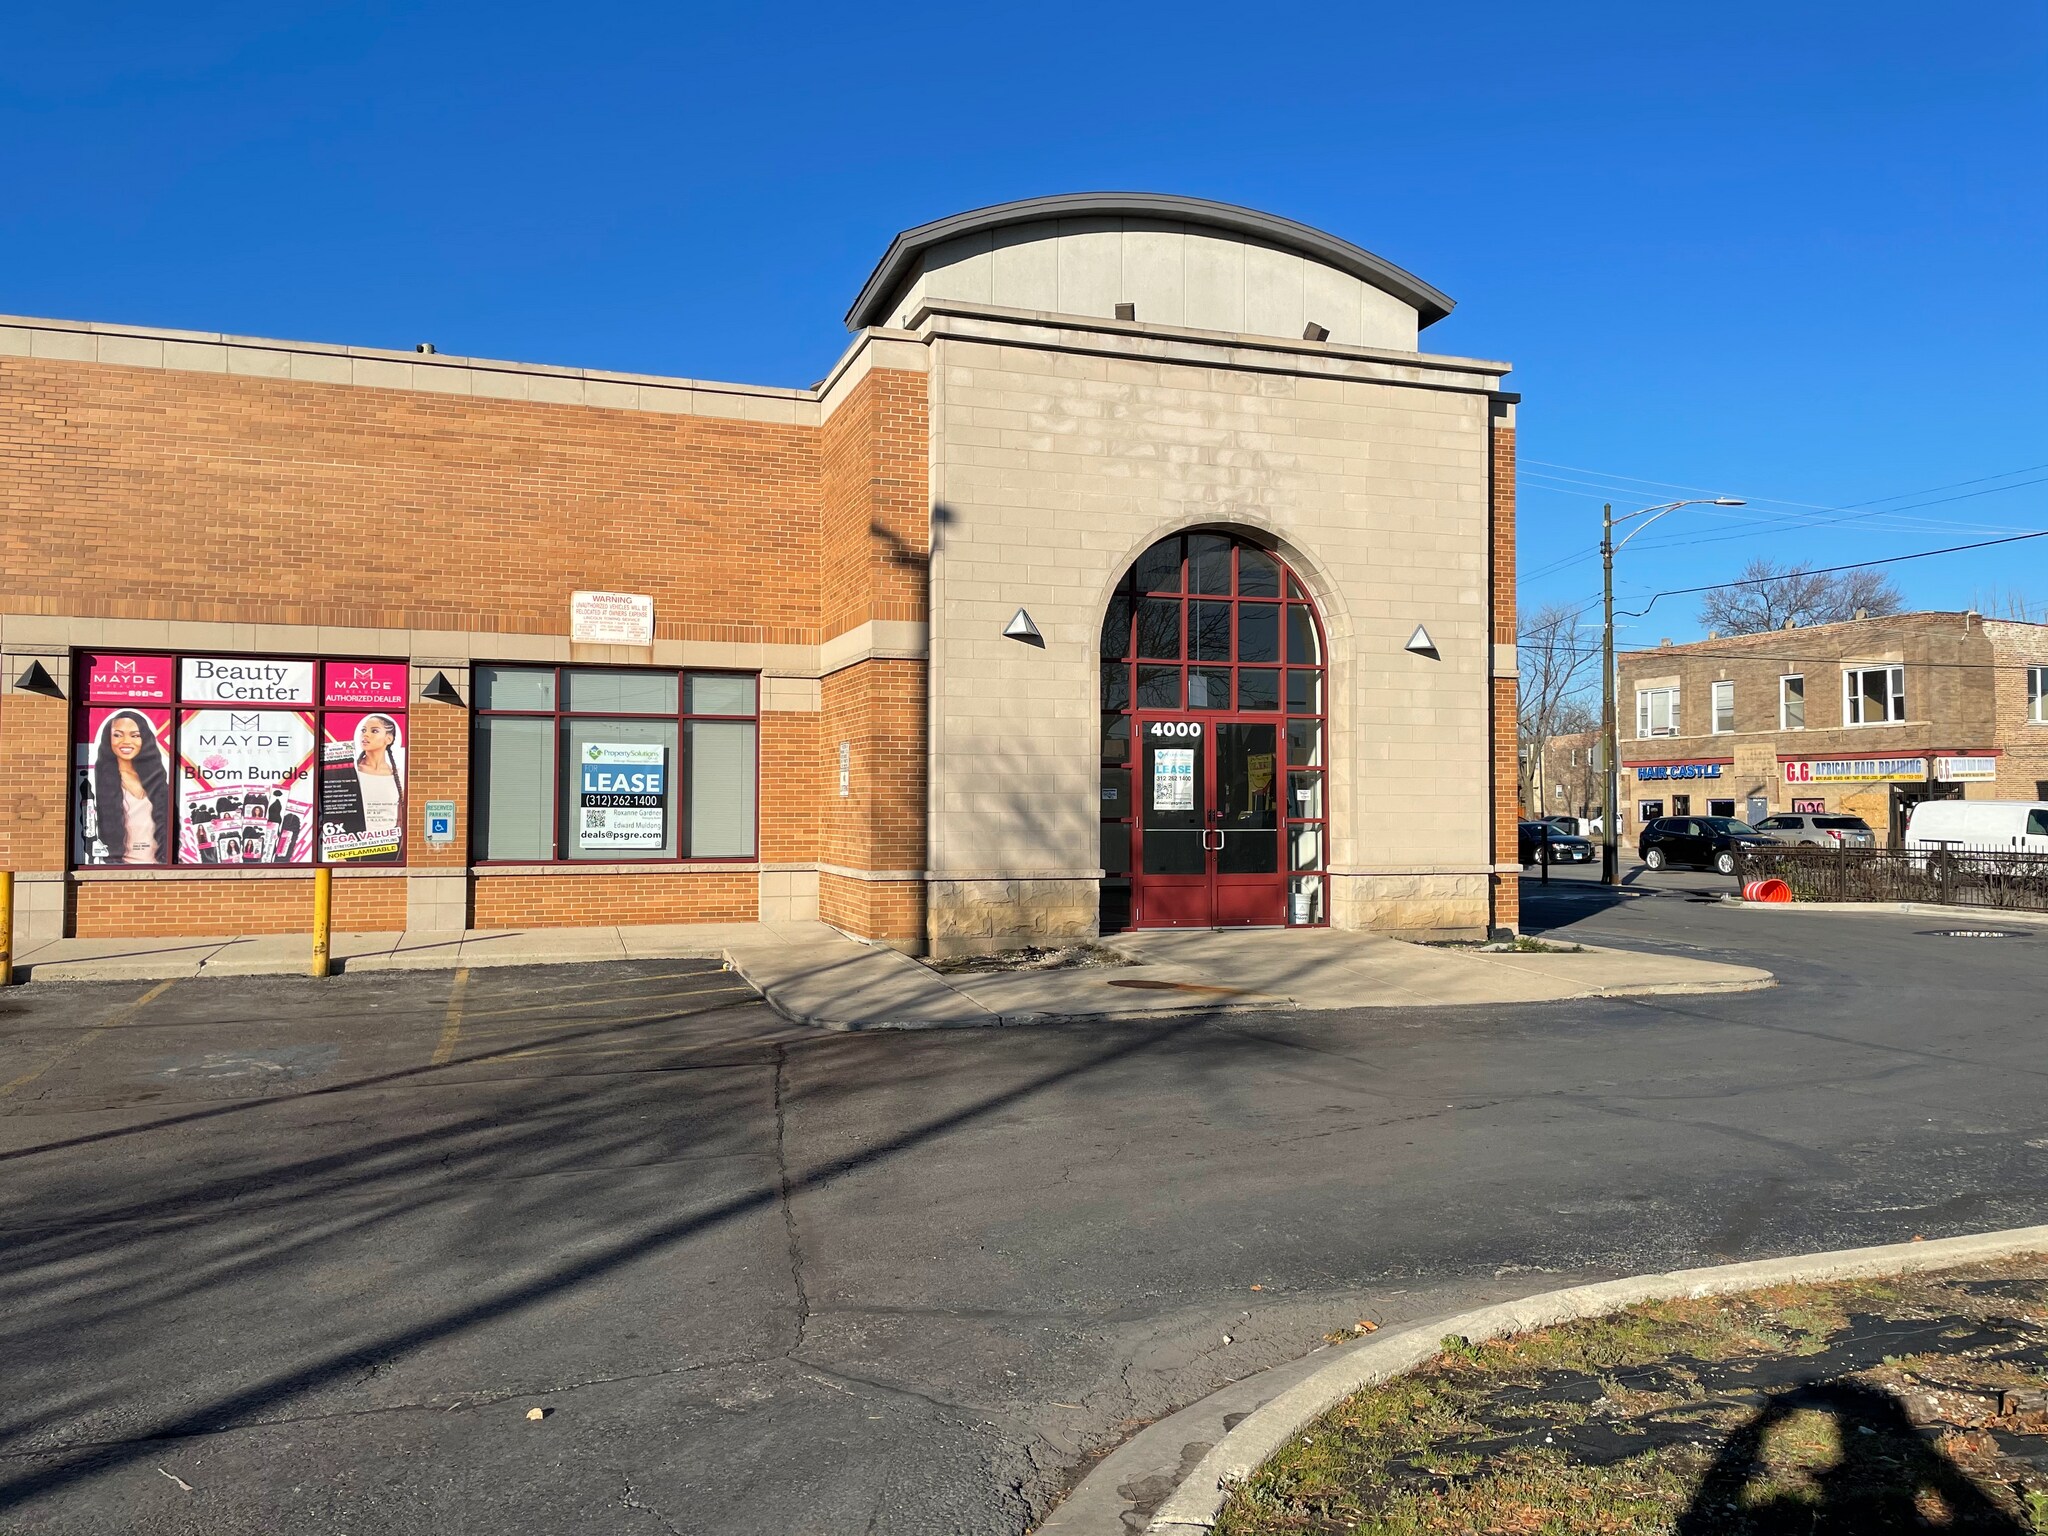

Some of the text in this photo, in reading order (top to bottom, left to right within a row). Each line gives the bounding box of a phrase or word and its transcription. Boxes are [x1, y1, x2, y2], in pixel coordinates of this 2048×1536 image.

[575, 602, 608, 610] UNAUTHORIZED
[610, 603, 630, 611] VEHICLES
[592, 595, 633, 604] WARNING
[94, 674, 157, 684] MAYDE
[195, 660, 288, 685] Beauty
[216, 681, 299, 700] Center
[335, 681, 392, 690] MAYDE
[325, 694, 401, 703] AUTHORIZED DEALER
[1150, 722, 1202, 737] 4000
[199, 735, 290, 747] MAYDE
[184, 766, 308, 780] Bloom Bundle
[1155, 765, 1192, 775] LEASE
[1638, 764, 1721, 779] HAIR CASTLE
[1786, 762, 1814, 782] G.G.
[1815, 761, 1851, 775] AFRICAN
[1855, 761, 1875, 774] HAIR
[1879, 760, 1921, 774] BRAIDING
[584, 773, 660, 792] LEASE
[586, 794, 657, 807] (312) 262-1400
[322, 822, 346, 836] 6x
[581, 830, 662, 840] deals@psgre.com
[322, 828, 400, 845] MEGA VALUE!
[328, 845, 397, 859] NON-FLAMMABLE
